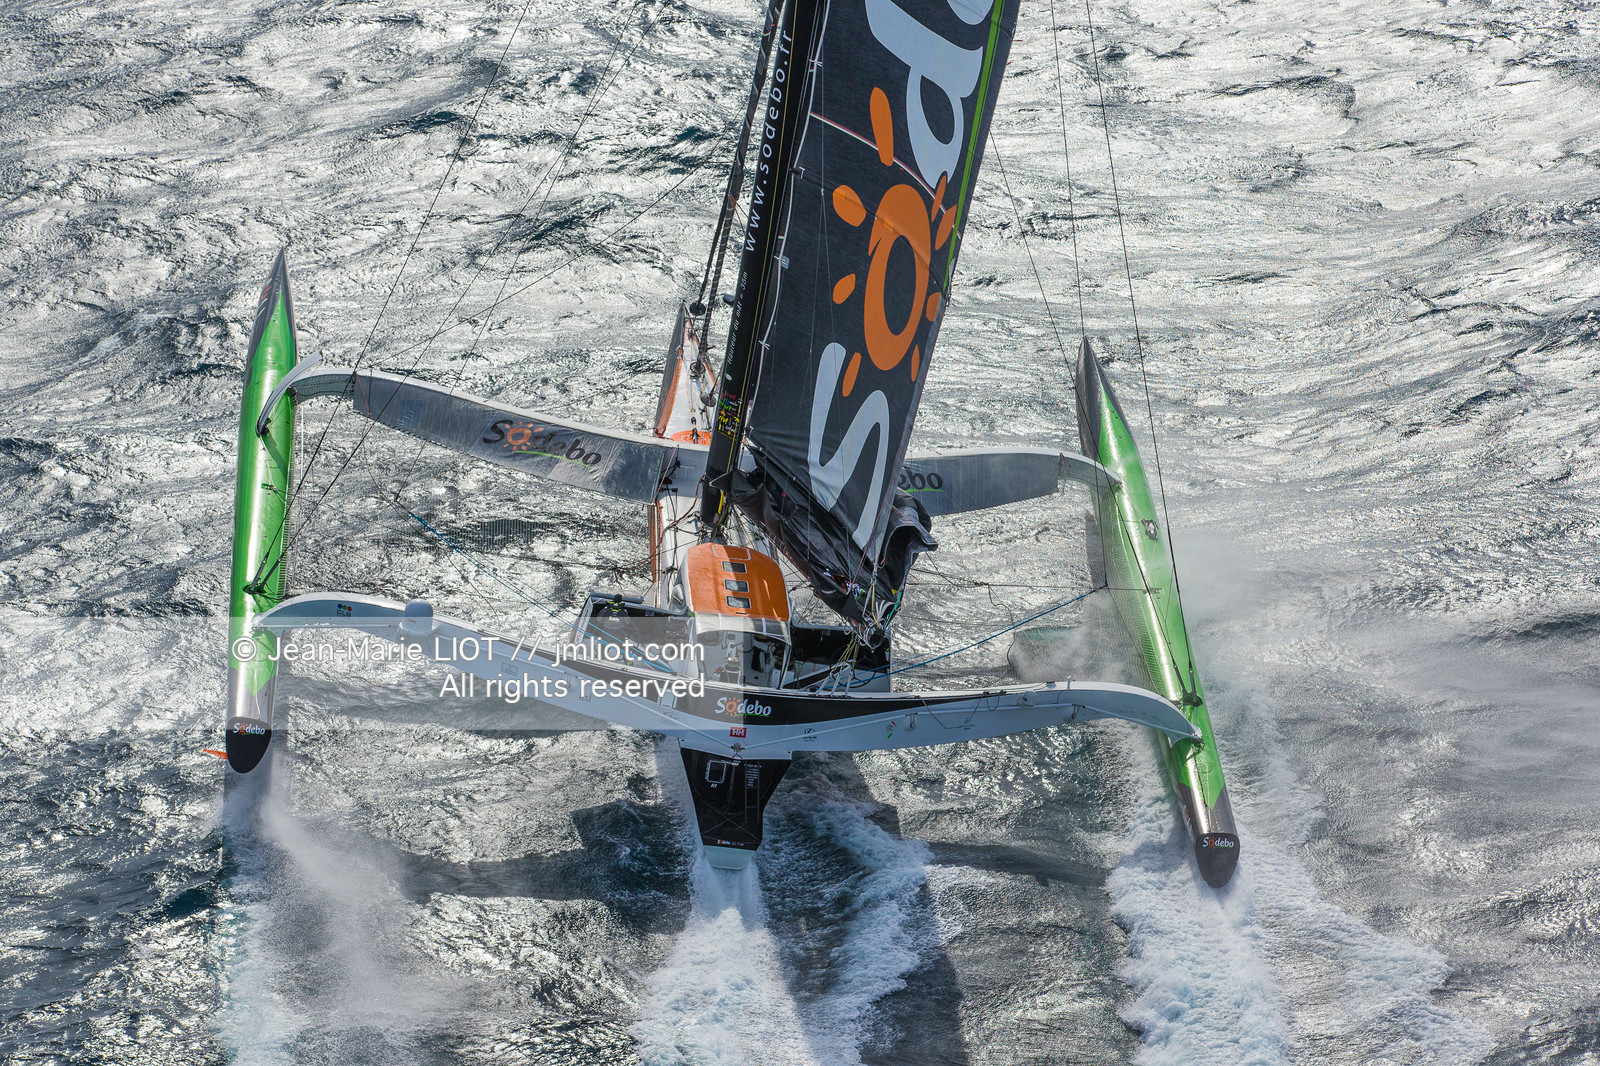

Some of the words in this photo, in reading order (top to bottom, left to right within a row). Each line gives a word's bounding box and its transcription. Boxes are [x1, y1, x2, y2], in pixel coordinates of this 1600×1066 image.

[745, 30, 793, 252] www.sodebo.fr
[482, 420, 602, 465] Sodebo
[715, 696, 772, 717] Sodebo
[232, 722, 266, 735] Sodebo
[1202, 836, 1235, 848] Sodebo
